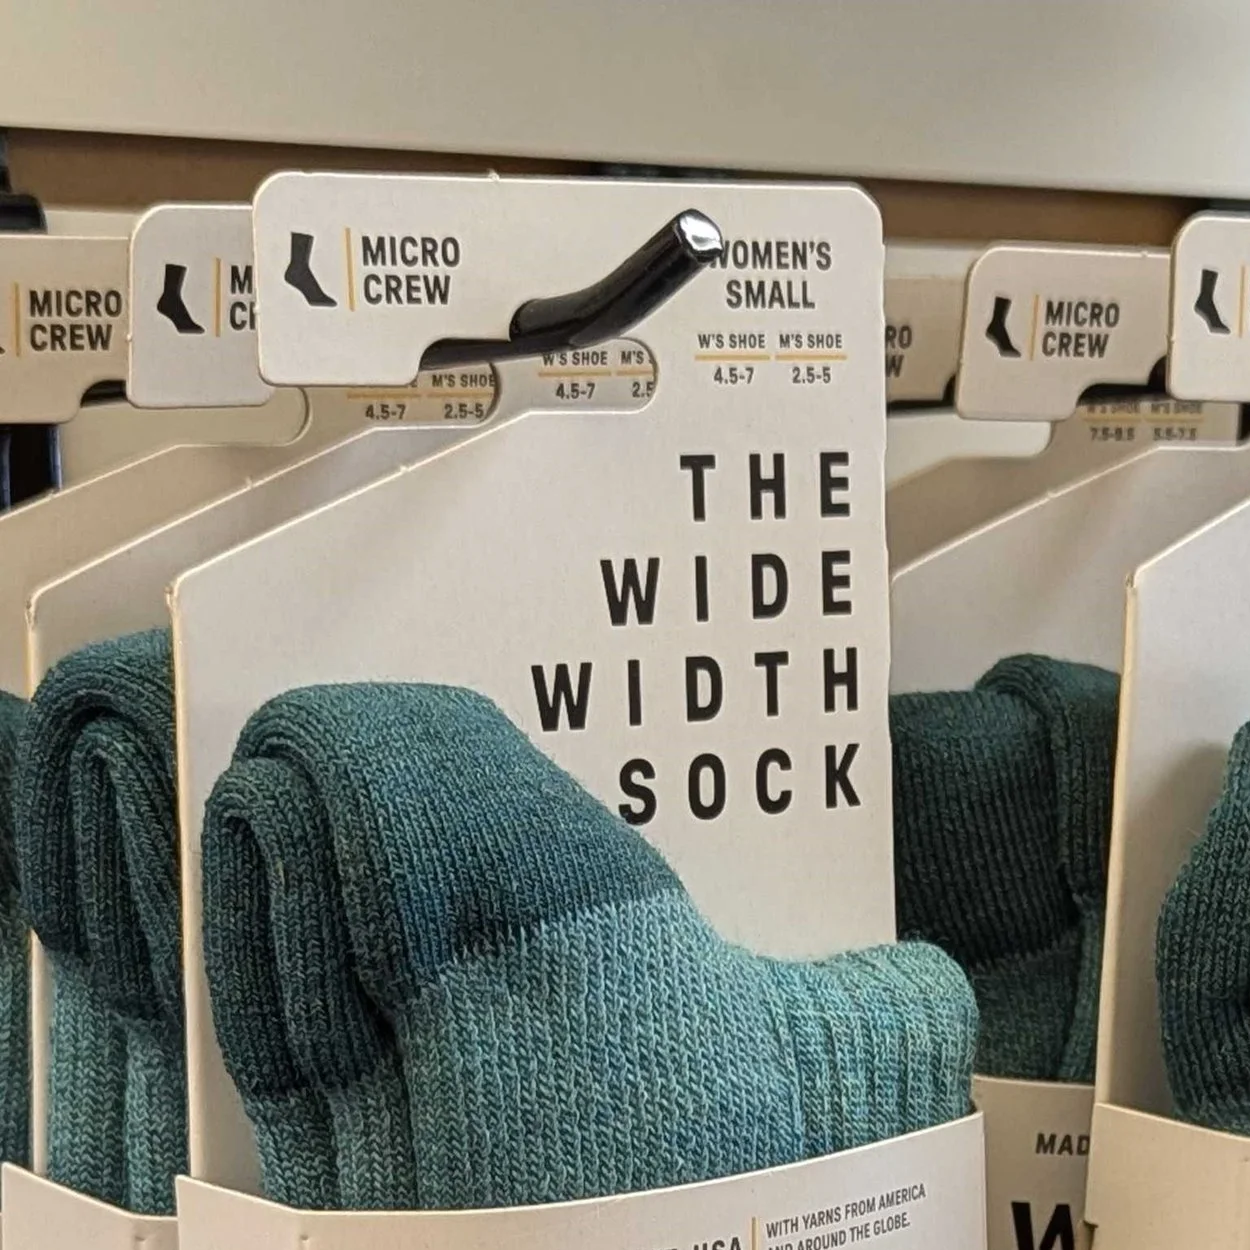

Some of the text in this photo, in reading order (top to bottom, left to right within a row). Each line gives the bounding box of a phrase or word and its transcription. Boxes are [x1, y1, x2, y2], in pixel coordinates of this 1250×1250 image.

[362, 236, 460, 266] MICRO
[363, 274, 451, 305] CREW
[726, 279, 815, 309] SMALL
[29, 291, 121, 317] MICRO
[1045, 300, 1120, 328] MICRO
[30, 325, 112, 352] CREW
[698, 334, 765, 349] W'S SHOE
[779, 334, 842, 349] M'S SHOE
[1042, 332, 1110, 358] CREW
[572, 352, 607, 366] SHOE
[714, 367, 754, 384] 4.5-7
[792, 366, 831, 384] 2.5-5
[556, 383, 595, 399] 4.5-7
[365, 405, 406, 420] 4.5-7
[444, 403, 484, 419] 2.5-5
[680, 452, 850, 521] THE
[600, 550, 852, 626] WIDE
[531, 647, 858, 732] WIDTH
[618, 743, 861, 825] SOCK
[1035, 1133, 1090, 1156] MAD
[766, 1183, 926, 1238] WITH YARNS FROM AMERICA
[850, 1222, 870, 1242] THE
[873, 1212, 911, 1236] GLOBE.
